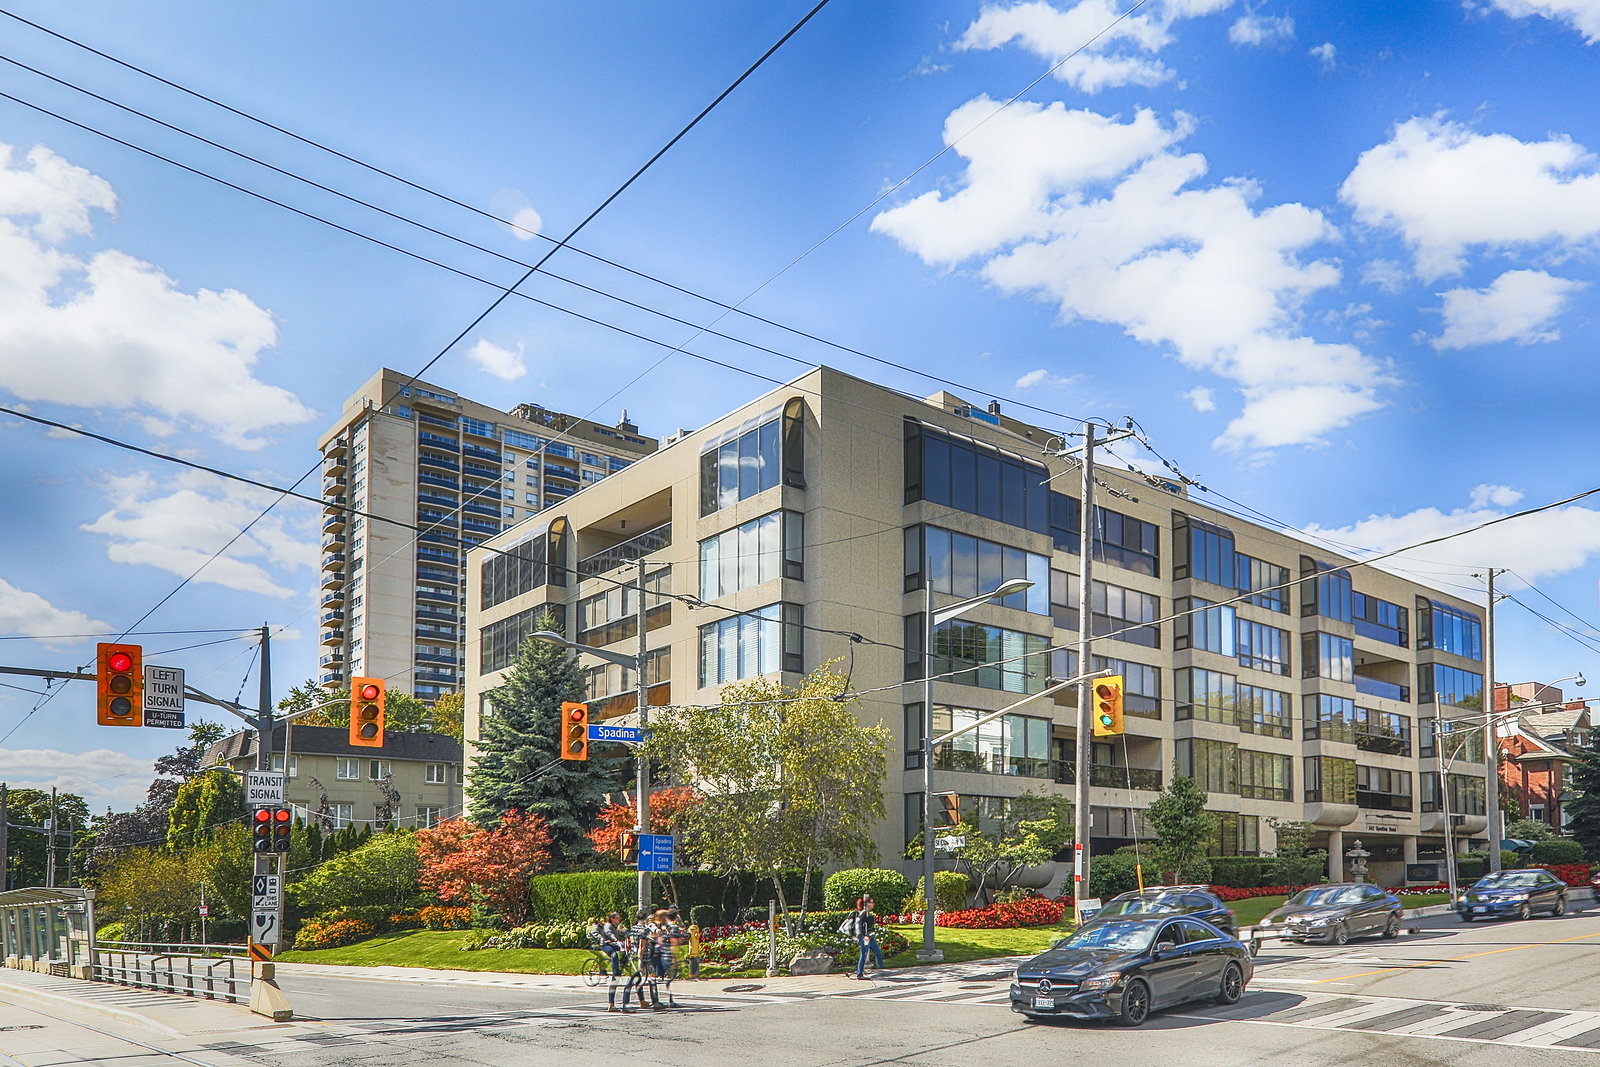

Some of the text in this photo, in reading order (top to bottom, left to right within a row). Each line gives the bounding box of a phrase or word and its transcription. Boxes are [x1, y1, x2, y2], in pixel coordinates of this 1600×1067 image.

[152, 669, 177, 681] LEFT
[151, 682, 178, 694] TURN
[147, 695, 182, 708] SIGNAL
[152, 712, 177, 720] U-TURN
[146, 718, 182, 727] PERMITTED
[598, 726, 635, 739] Spadina
[248, 775, 283, 787] TRANSIT
[250, 788, 281, 800] SIGNAL
